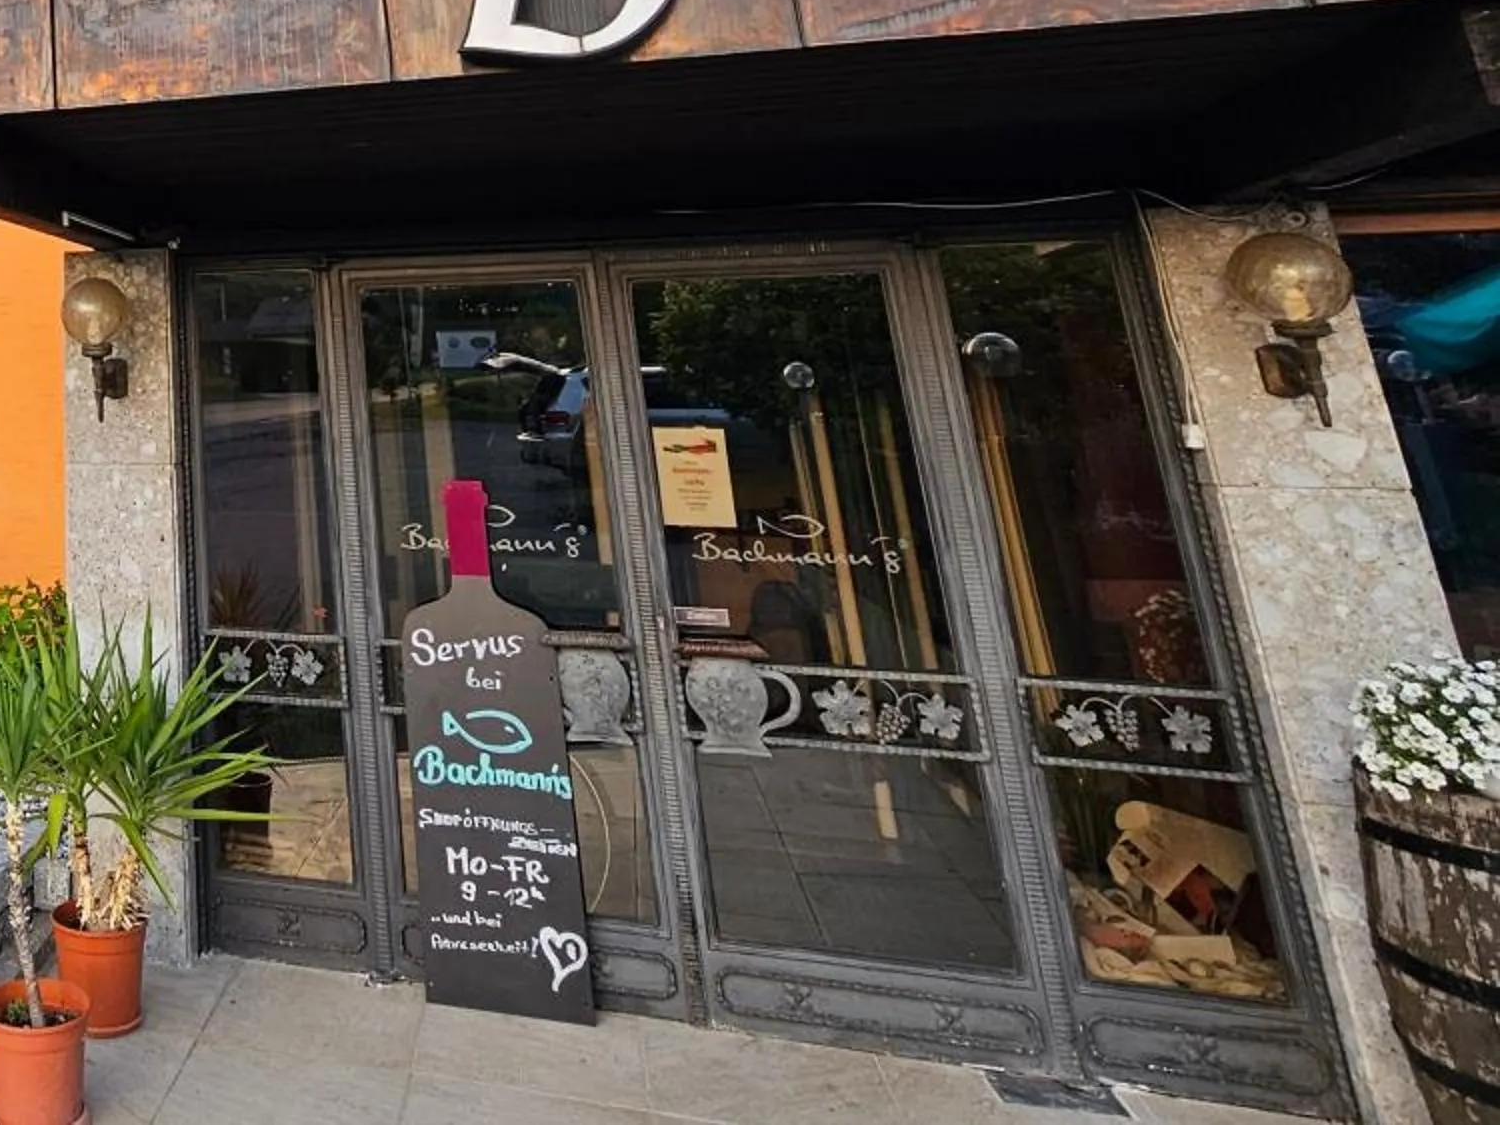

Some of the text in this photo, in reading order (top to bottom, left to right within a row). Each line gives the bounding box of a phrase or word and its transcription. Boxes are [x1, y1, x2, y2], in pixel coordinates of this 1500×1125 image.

[410, 627, 525, 666] Servus
[465, 666, 501, 690] bei
[412, 745, 573, 800] Bachmann's
